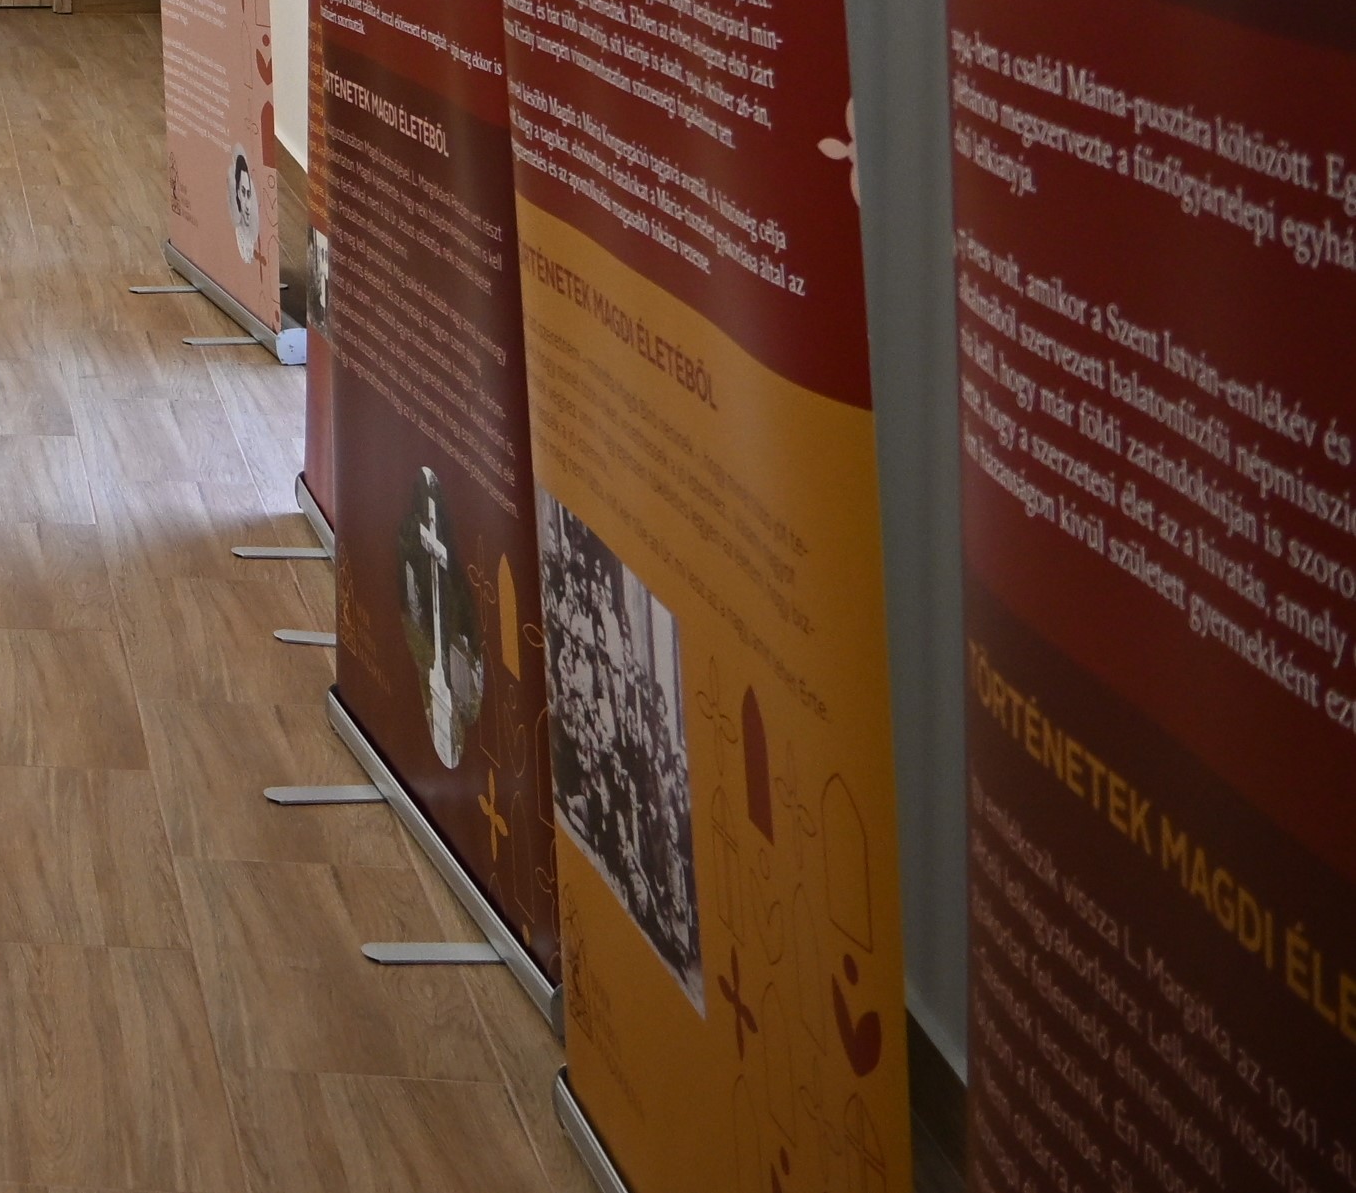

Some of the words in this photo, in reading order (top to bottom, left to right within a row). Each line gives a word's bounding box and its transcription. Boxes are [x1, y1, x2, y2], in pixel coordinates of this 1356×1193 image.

[727, 50, 748, 79] első
[749, 59, 775, 89] zárt
[750, 22, 783, 50] min-
[370, 92, 397, 128] MAGDI
[398, 104, 449, 157] ÉLETÉBŐL
[1000, 104, 1112, 168] megszervezte
[1012, 54, 1062, 95] család
[1215, 116, 1317, 189] költözött.
[758, 218, 786, 254] célja
[759, 253, 785, 288] által
[593, 286, 633, 349] MAGDI
[638, 313, 718, 411] ÉLETÉBŐL
[1019, 323, 1104, 388] szervezett
[1109, 359, 1230, 463] balatonfűzfői
[1025, 274, 1087, 324] amikor
[1106, 302, 1158, 361] Szent
[1163, 330, 1315, 444] István-emlékév
[1322, 418, 1351, 465] és
[998, 351, 1036, 412] hogy
[1039, 387, 1074, 426] már
[1078, 400, 1121, 454] földi
[1126, 436, 1257, 541] zarándokútján
[1263, 512, 1282, 557] is
[983, 390, 1016, 450] hogy
[1031, 435, 1115, 505] szerzetesi
[1119, 481, 1154, 531] élet
[1158, 513, 1179, 547] az
[1196, 527, 1270, 616] hivatás,
[1275, 593, 1347, 668] amely
[1058, 494, 1104, 554] kívül
[1108, 537, 1185, 609] született
[1189, 594, 1318, 706] gyermekként
[969, 639, 1153, 856] TÖRTÉNETEK
[1161, 816, 1273, 970] MAGDI
[1062, 877, 1118, 947] vissza
[1122, 924, 1142, 971] L.
[1145, 946, 1231, 1060] Margitka
[1236, 1047, 1261, 1092] az
[1266, 1076, 1324, 1155] 1941.
